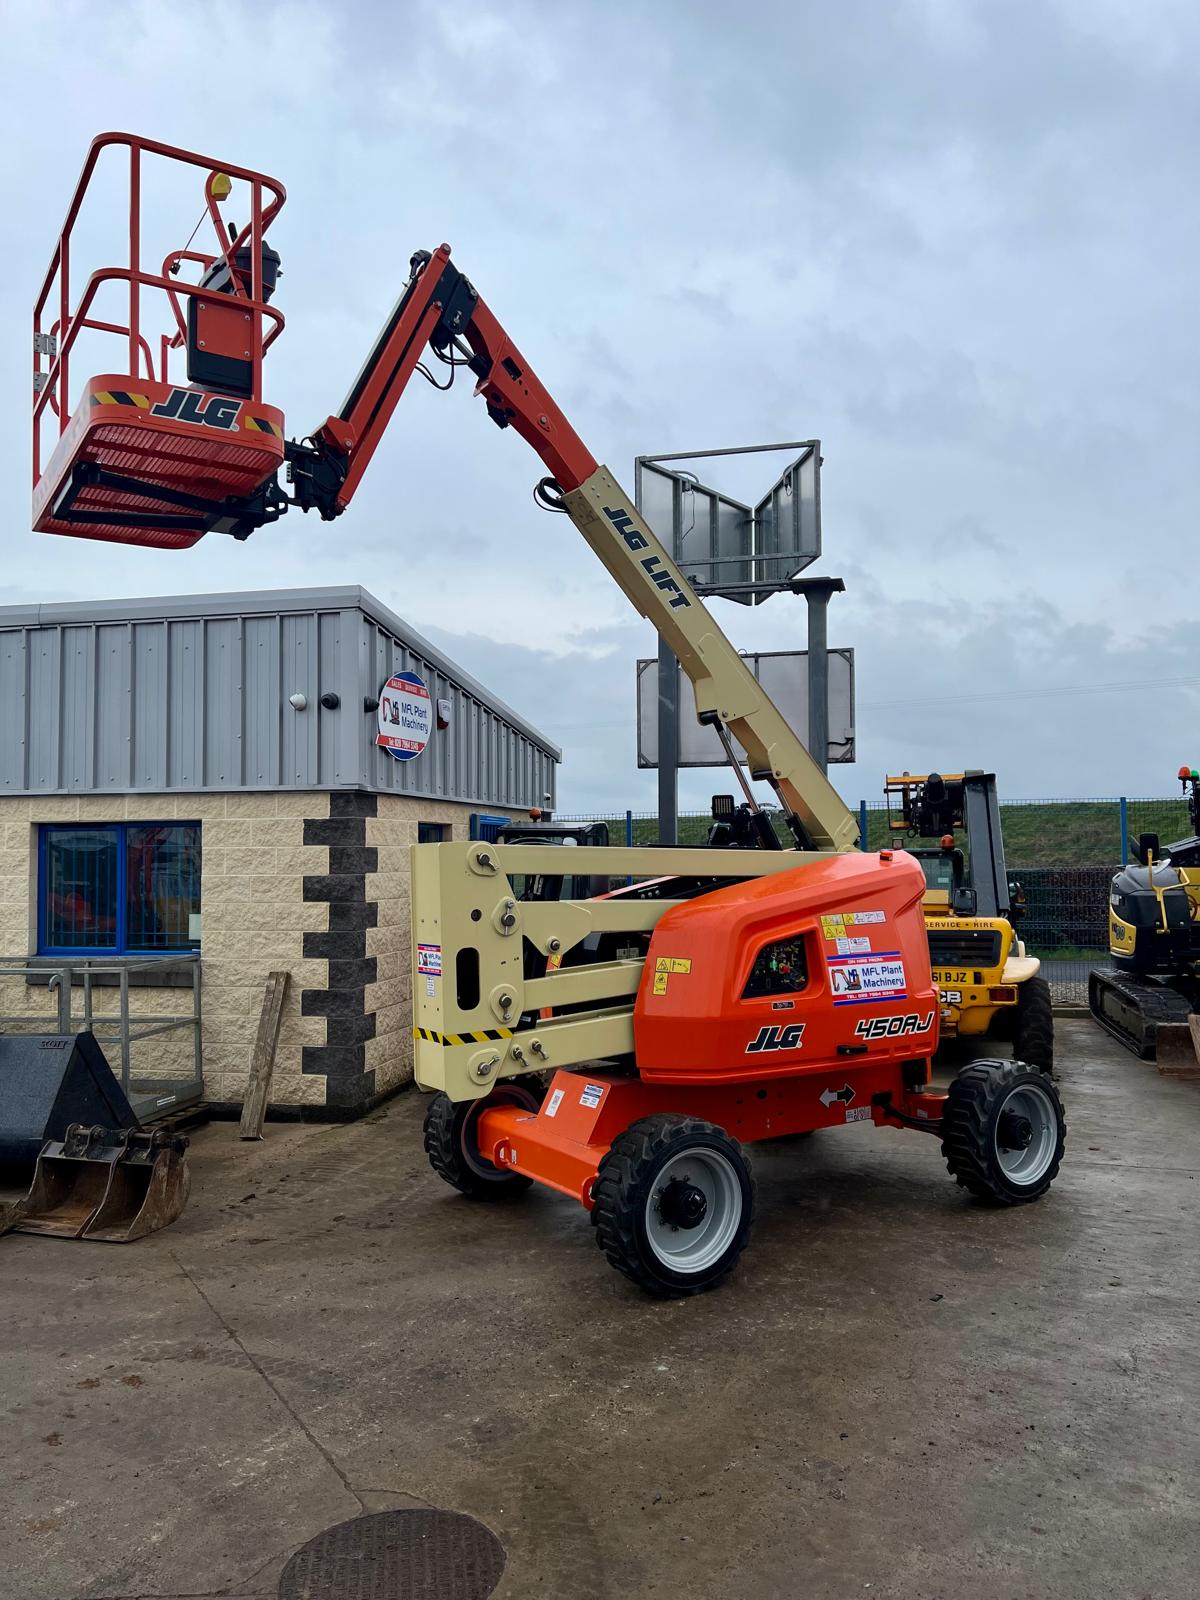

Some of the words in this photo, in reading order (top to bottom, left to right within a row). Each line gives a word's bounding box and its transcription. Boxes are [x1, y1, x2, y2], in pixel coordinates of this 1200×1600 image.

[150, 388, 243, 431] JLG
[601, 506, 650, 552] JLG
[640, 555, 692, 610] LIFT
[414, 705, 428, 719] Plant
[401, 716, 428, 735] Machinery
[861, 967, 880, 977] MFL
[881, 965, 903, 975] Plant
[944, 971, 967, 983] BJZ
[863, 977, 904, 988] Machinery
[854, 1012, 935, 1040] 450AJ
[745, 1023, 806, 1053] JLG
